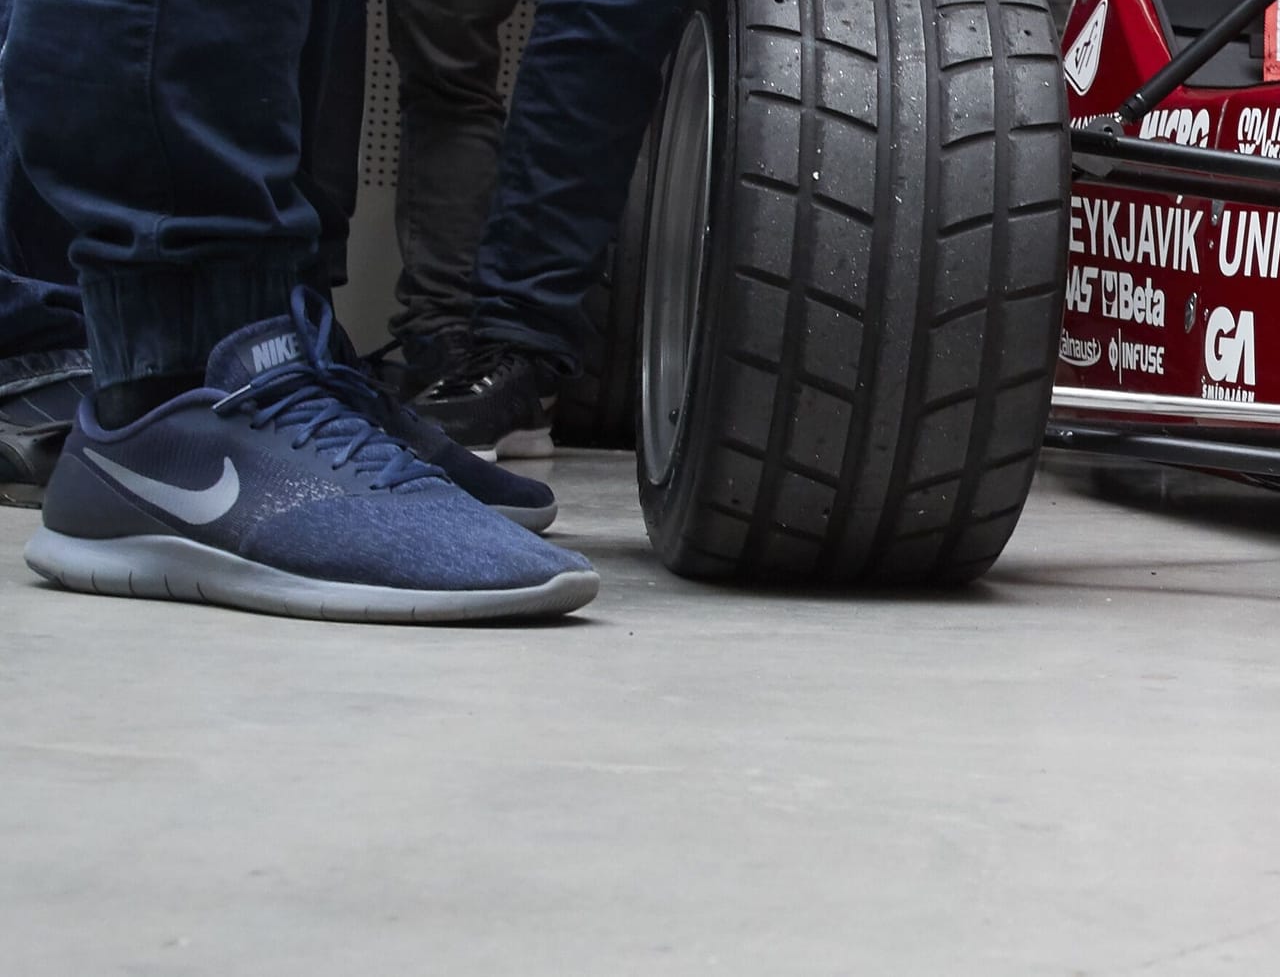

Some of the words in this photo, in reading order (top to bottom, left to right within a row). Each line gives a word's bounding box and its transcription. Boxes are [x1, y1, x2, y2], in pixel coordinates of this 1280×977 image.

[1068, 195, 1204, 274] EYKJAVÍK
[1119, 272, 1165, 327] Beta
[252, 332, 301, 373] NIKE
[1122, 341, 1165, 375] INFUSE
[1205, 306, 1256, 386] GA
